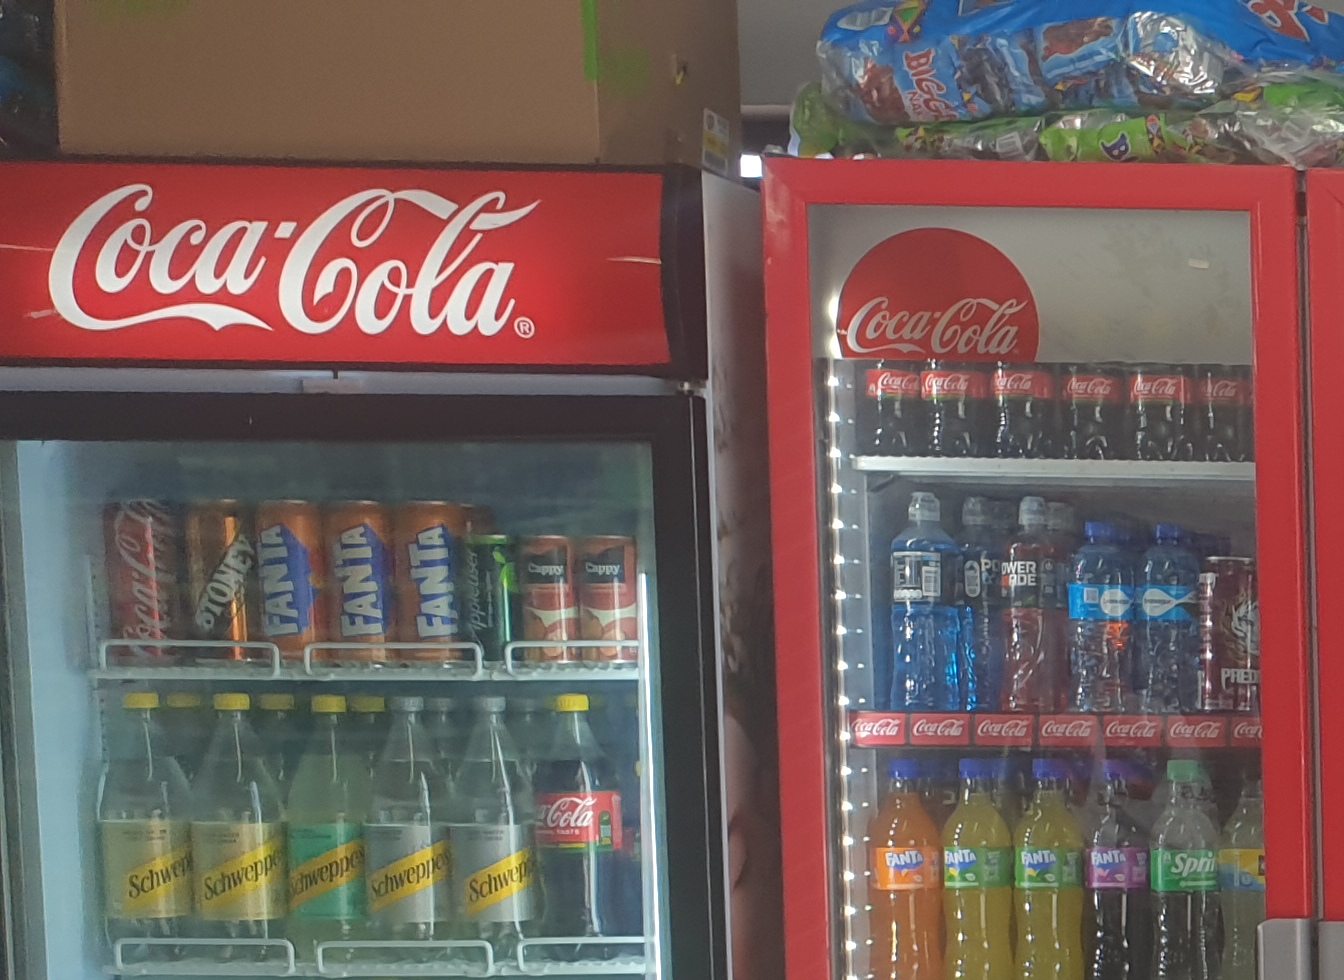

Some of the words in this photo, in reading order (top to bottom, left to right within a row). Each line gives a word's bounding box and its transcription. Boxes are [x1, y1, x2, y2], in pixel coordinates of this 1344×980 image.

[49, 181, 541, 336] Coca-Cola
[847, 296, 1029, 355] Coca-Cola
[528, 563, 564, 576] Cappy
[586, 562, 620, 575] Cappy
[1001, 561, 1037, 574] OWER
[195, 533, 254, 629] STONEY
[258, 524, 300, 636] FANTA
[334, 526, 383, 636] FANTA
[408, 526, 459, 637] FANTA
[913, 718, 964, 737] Coca-Cola
[977, 719, 1032, 738] Coca-Cola
[1041, 719, 1093, 738] Coca-Cola
[1106, 720, 1157, 738] Coca-Cola
[1170, 721, 1221, 739] Coca-Cola
[885, 850, 924, 867] FANTA
[944, 849, 977, 864] FANTA
[1020, 849, 1057, 865] FANTA
[1091, 850, 1127, 866] FANTA
[1170, 850, 1216, 877] Spri
